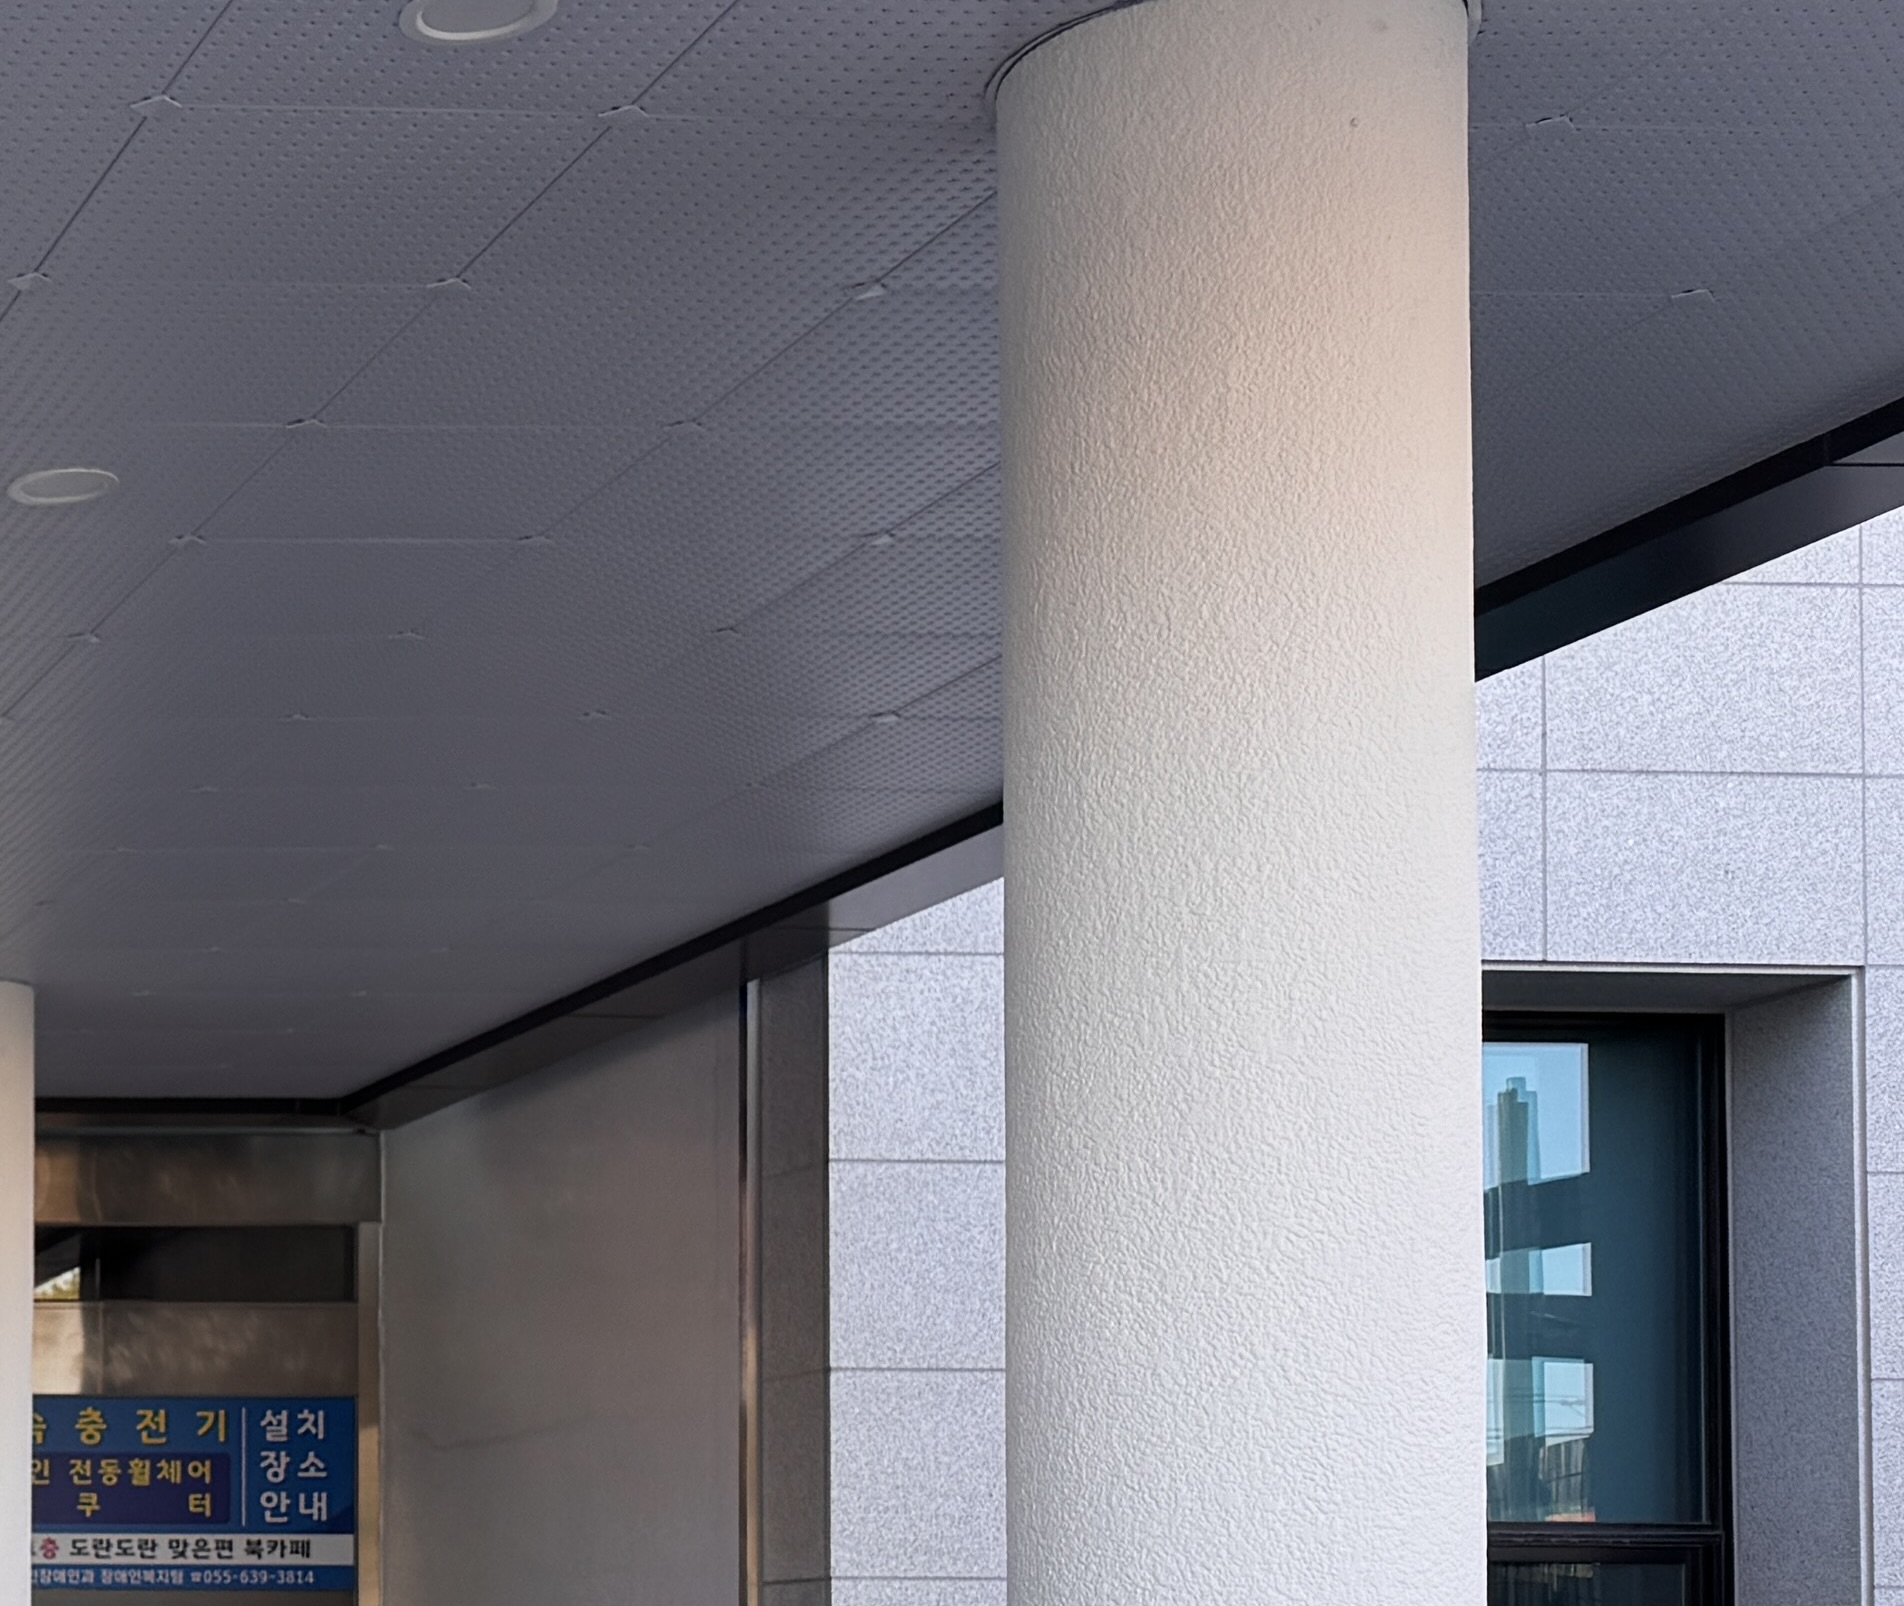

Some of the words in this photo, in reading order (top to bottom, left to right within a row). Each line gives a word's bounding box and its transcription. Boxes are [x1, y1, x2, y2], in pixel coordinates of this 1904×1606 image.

[259, 1409, 325, 1442] 설치
[68, 1458, 212, 1487] 전동휠체어
[259, 1450, 327, 1483] 장소
[259, 1490, 328, 1523] 안내
[32, 1537, 59, 1560] 층
[69, 1537, 158, 1560] 도란도란
[167, 1537, 234, 1561] 맞은편
[243, 1537, 312, 1560] 북카페
[203, 1568, 316, 1585] 055-639-3814
